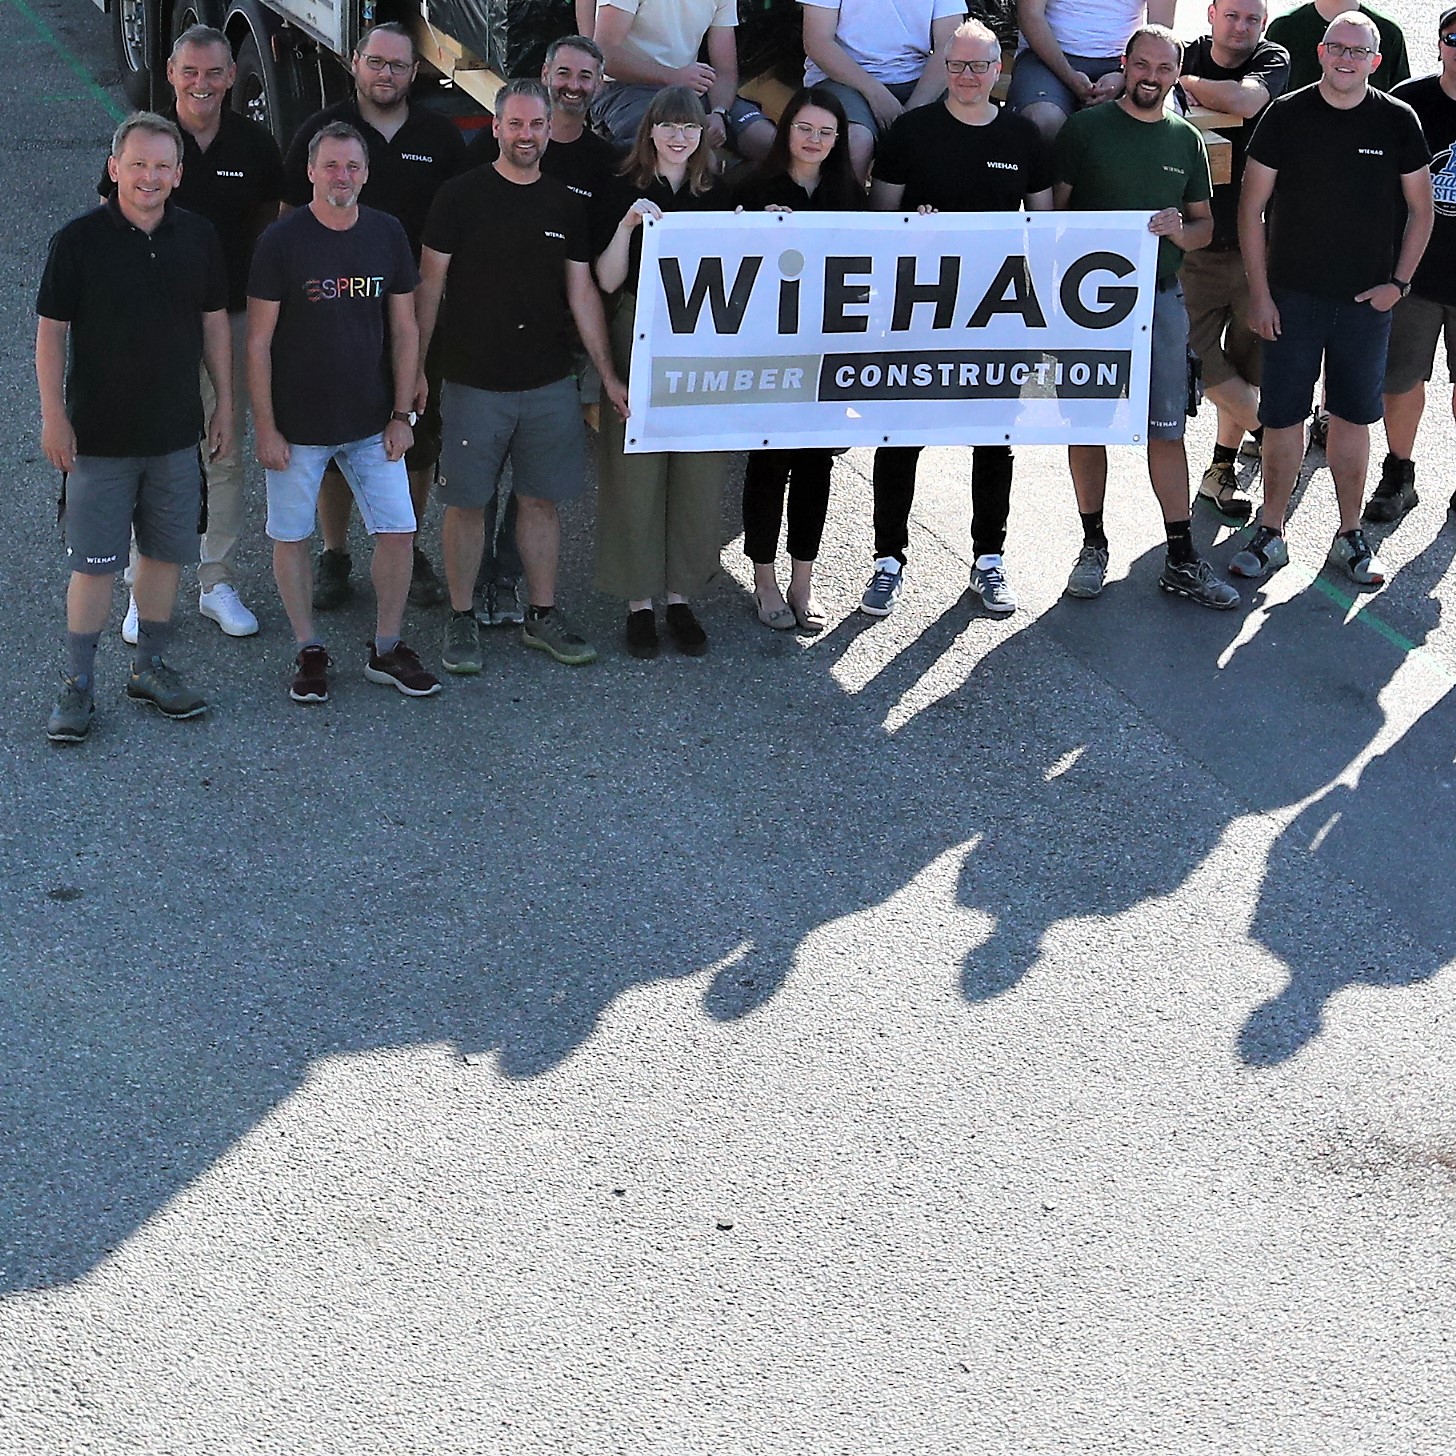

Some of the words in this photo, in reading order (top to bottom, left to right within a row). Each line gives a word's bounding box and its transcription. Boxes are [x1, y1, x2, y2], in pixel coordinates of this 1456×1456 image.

[401, 152, 433, 163] WIEHAG
[986, 161, 1019, 171] WIEHAG
[305, 276, 384, 302] ESPRIT
[664, 367, 804, 394] TIMBER
[834, 362, 1119, 389] CONSTRUCTION
